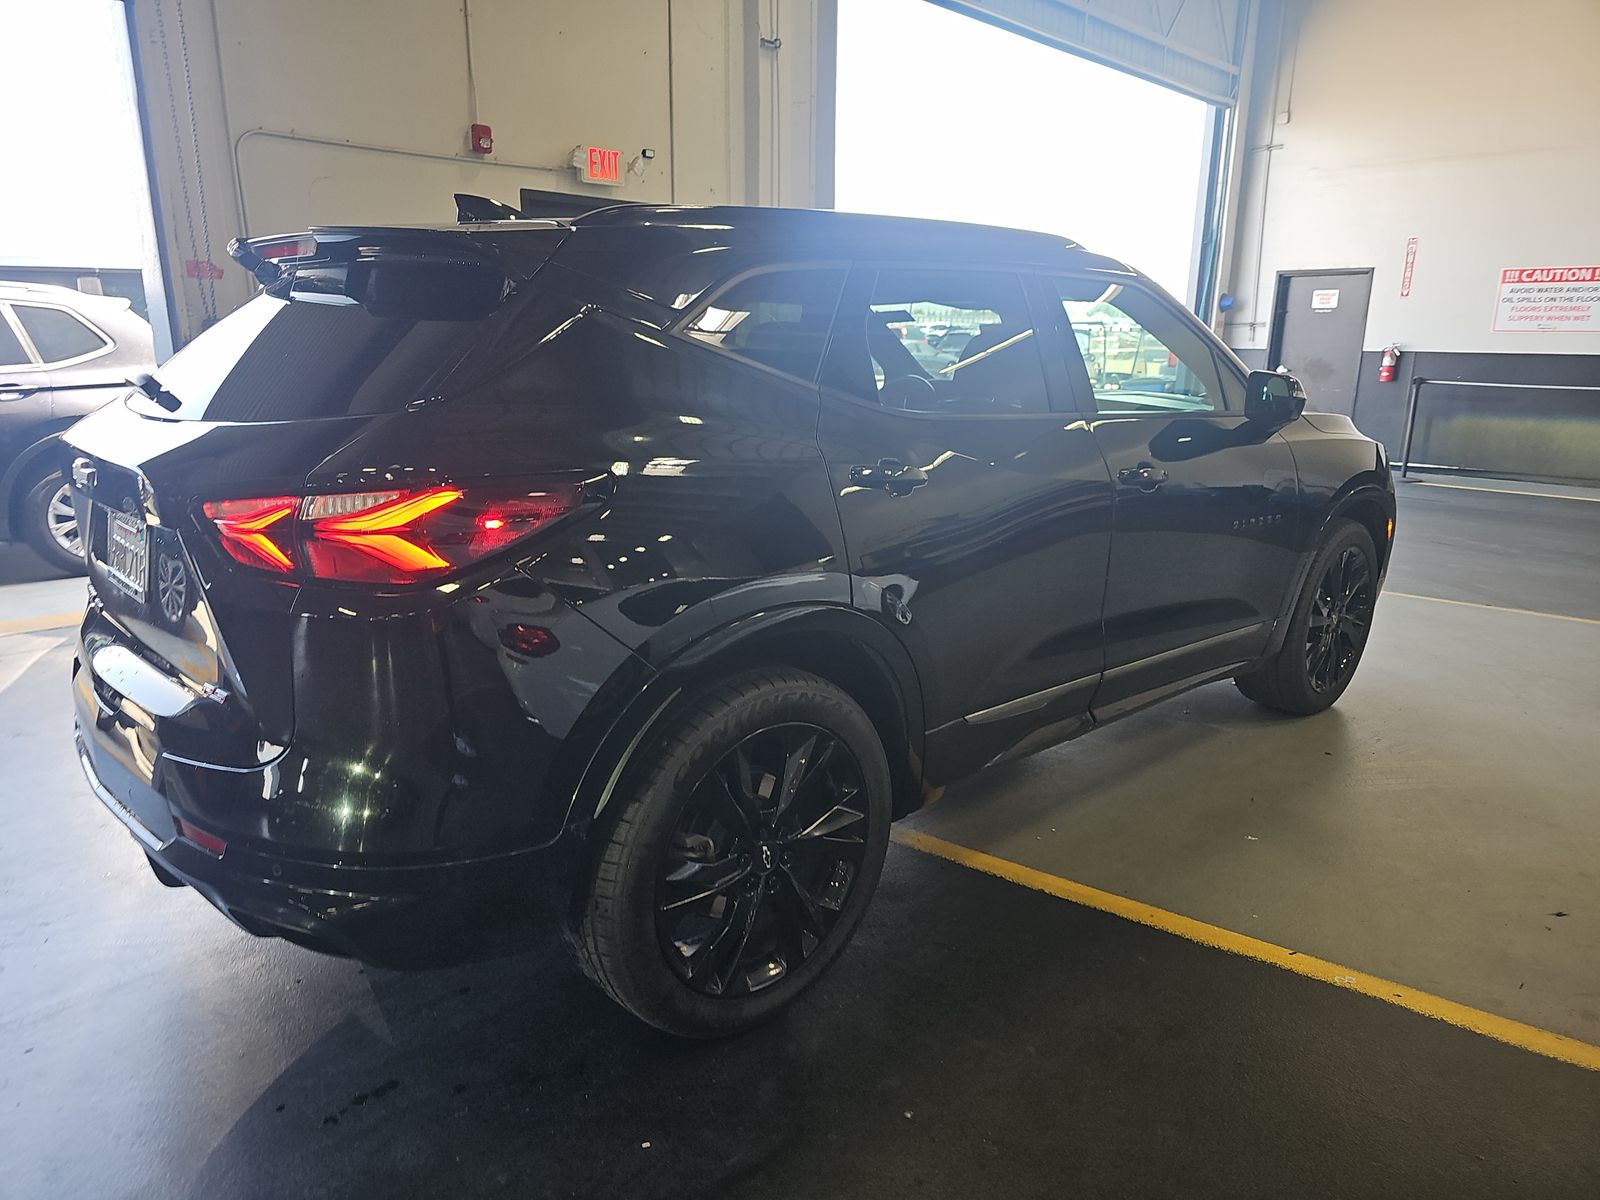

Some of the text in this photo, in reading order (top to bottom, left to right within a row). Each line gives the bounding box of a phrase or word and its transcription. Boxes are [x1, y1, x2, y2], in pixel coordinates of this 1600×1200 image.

[589, 148, 619, 180] EXIT
[1505, 270, 1520, 282] !!!
[1521, 268, 1592, 281] CAUTION
[1501, 296, 1515, 304] OIL
